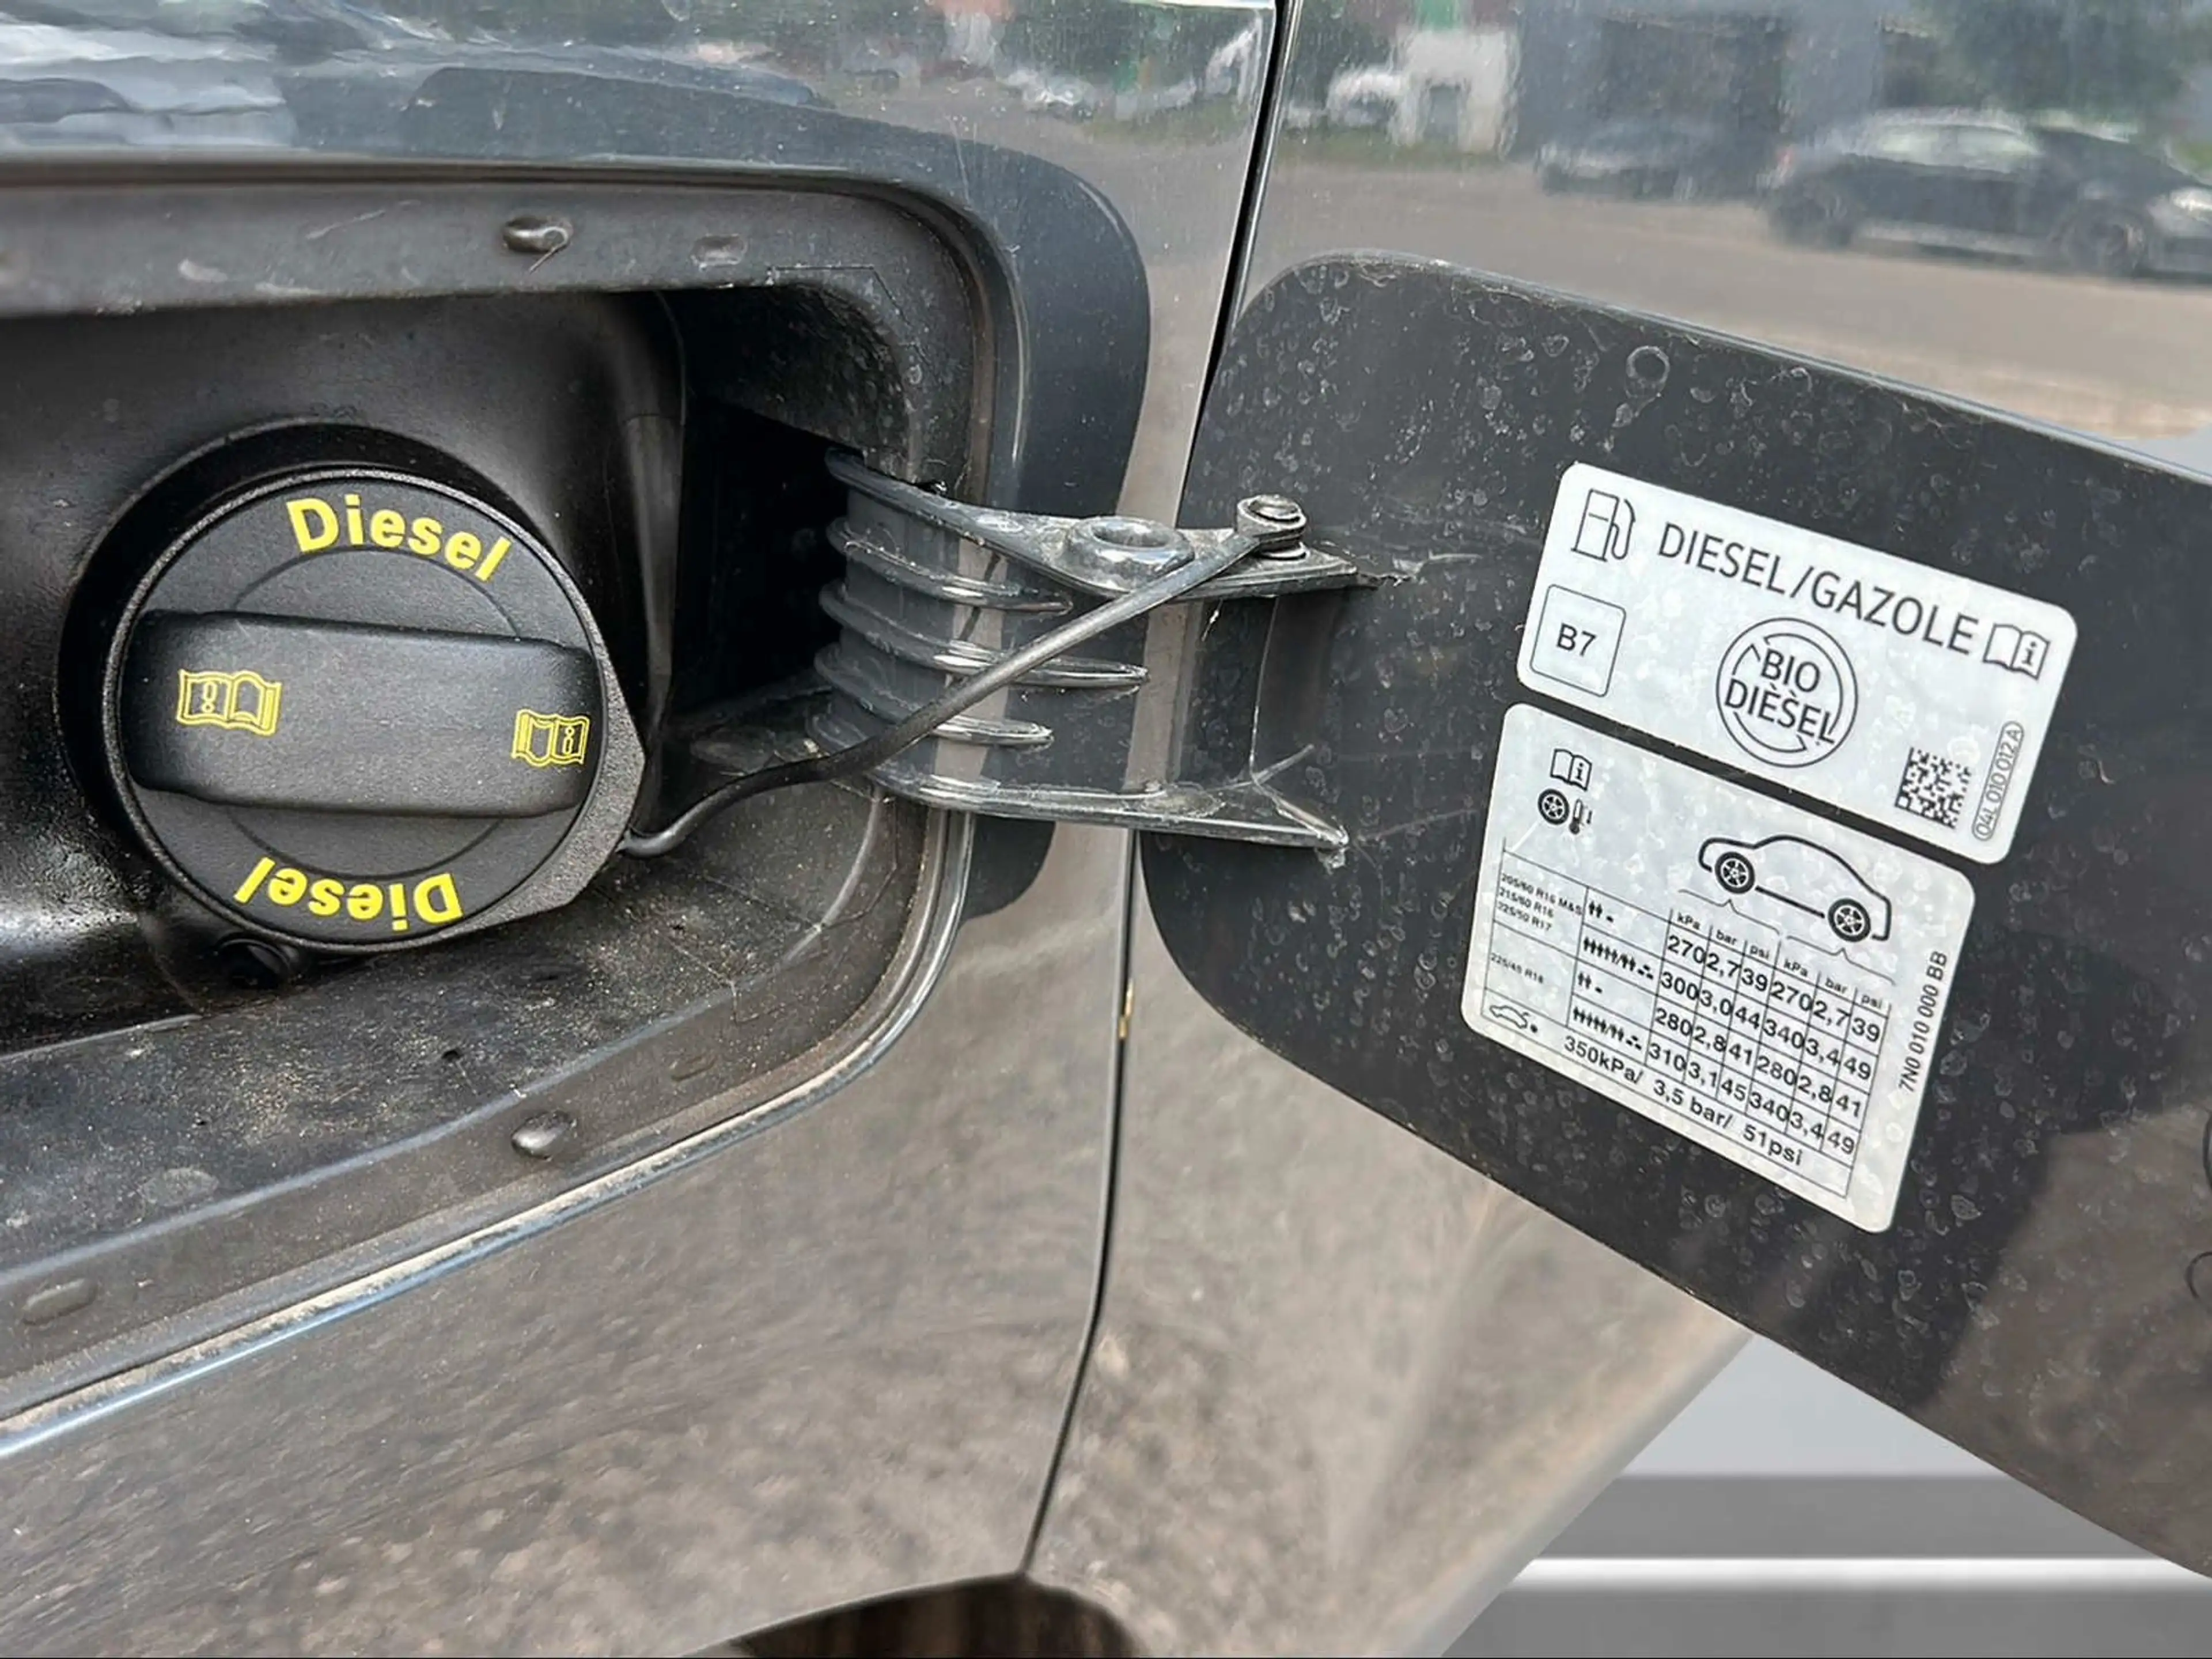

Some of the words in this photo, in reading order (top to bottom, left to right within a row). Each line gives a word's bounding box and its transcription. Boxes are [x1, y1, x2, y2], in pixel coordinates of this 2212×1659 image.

[286, 494, 512, 582] Diesel
[1658, 522, 1979, 656] DIESEL/GAZOLE
[1555, 622, 1597, 658] B7
[1760, 646, 1822, 694] BIO
[1724, 679, 1836, 745] DIESEL
[234, 857, 463, 931] Diesel
[1668, 935, 1707, 964] 270
[1707, 953, 1741, 978] 2,7
[1741, 968, 1768, 992] 39
[1770, 981, 1813, 1012] 270
[1813, 1000, 1851, 1027] 2,7
[1851, 1017, 1880, 1043] 39
[1677, 912, 1701, 931] kPa
[1716, 929, 1737, 945] bar
[1750, 945, 1770, 960] psi
[1783, 959, 1808, 977] kPa
[1824, 978, 1848, 993] bar
[1861, 995, 1883, 1009] psi
[1917, 984, 1939, 1018] 000
[1927, 951, 1948, 981] BB
[1654, 1007, 1692, 1037] 280
[1693, 1025, 1728, 1052] 2,8
[1729, 1043, 1753, 1066] 41
[1756, 1055, 1797, 1086] 280
[1797, 1074, 1832, 1104] 2,8
[1835, 1095, 1862, 1118] 41
[1660, 971, 1699, 1001] 300
[1700, 990, 1732, 1016] 3,0
[1734, 1006, 1760, 1030] 44
[1763, 1018, 1804, 1050] 340
[1805, 1038, 1840, 1066] 3,4
[1843, 1056, 1871, 1081] 49
[1909, 1021, 1930, 1055] 010
[1563, 1035, 1643, 1085] 350kPa/
[1653, 1079, 1684, 1105] 3,5
[1690, 1096, 1733, 1130] bar/
[1743, 1124, 1804, 1166] 51psi
[1648, 1043, 1686, 1072] 310
[1688, 1062, 1718, 1087] 3,1
[1721, 1079, 1747, 1101] 45
[1748, 1092, 1790, 1122] 340
[1790, 1111, 1824, 1139] 3,4
[1827, 1131, 1855, 1156] 49
[1898, 1056, 1921, 1093] 7N0
